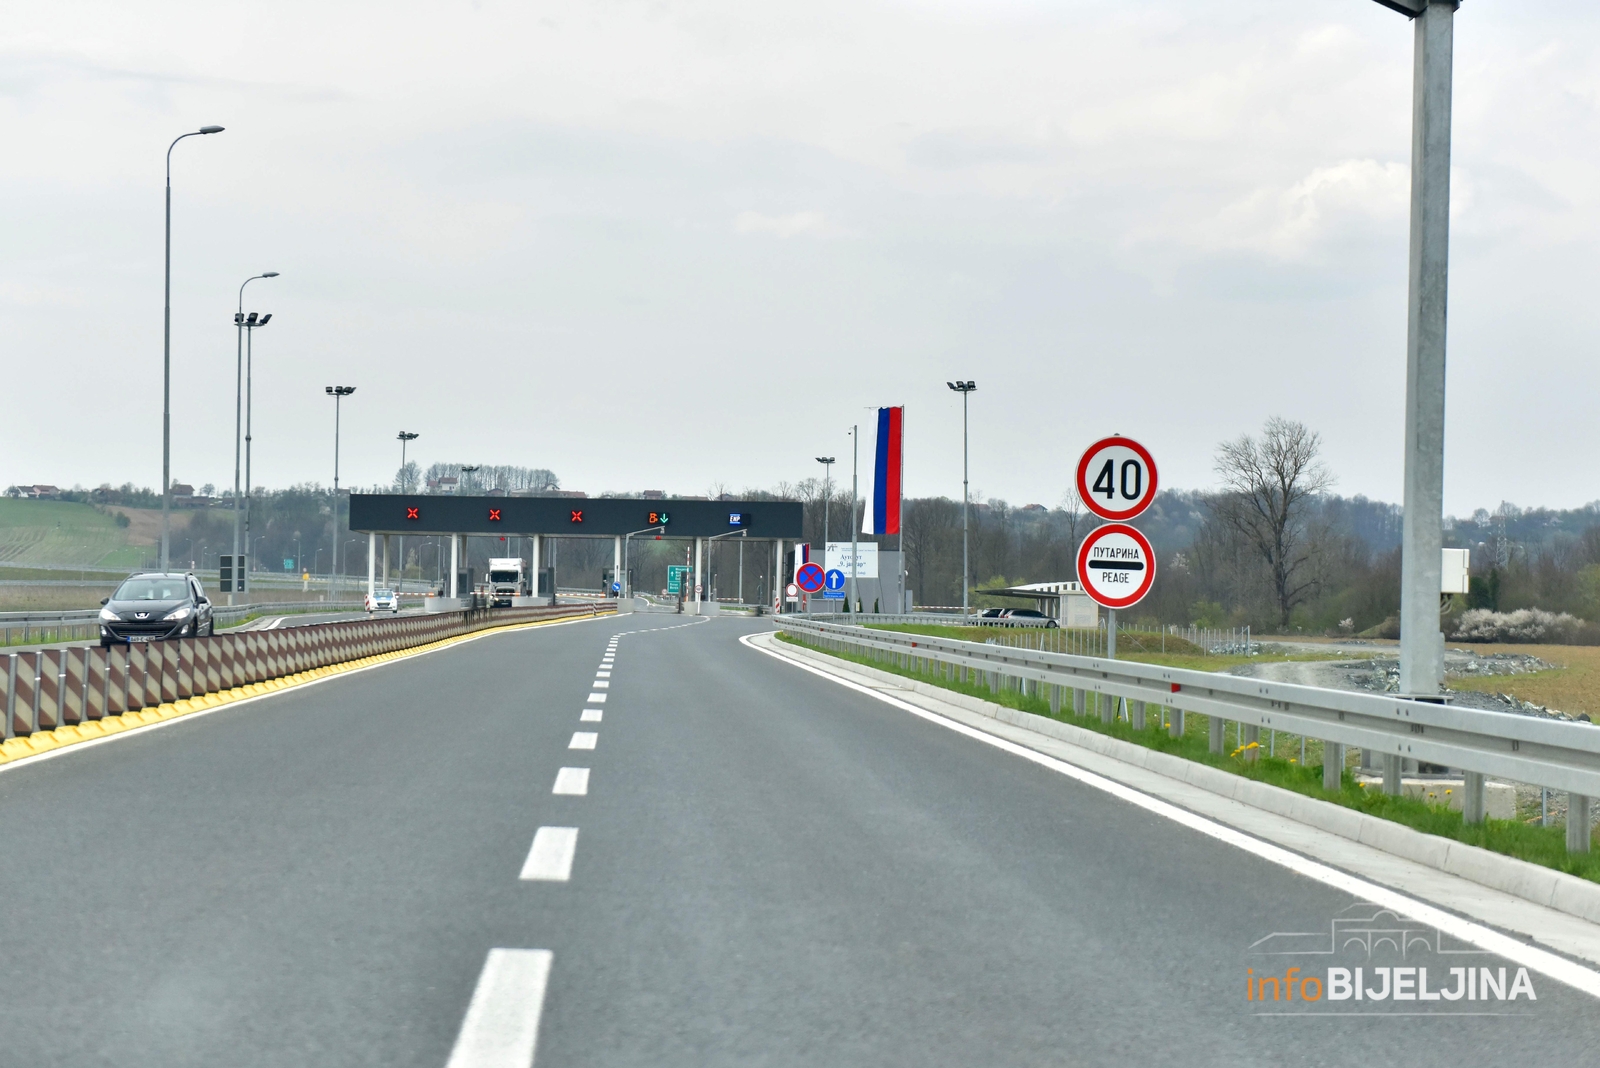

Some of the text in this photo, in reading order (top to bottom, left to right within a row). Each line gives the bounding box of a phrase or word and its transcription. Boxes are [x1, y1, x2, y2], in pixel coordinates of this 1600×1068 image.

[1092, 459, 1142, 500] 40
[1094, 547, 1139, 559] ПУТАРИНА
[1102, 571, 1130, 584] PEAGE
